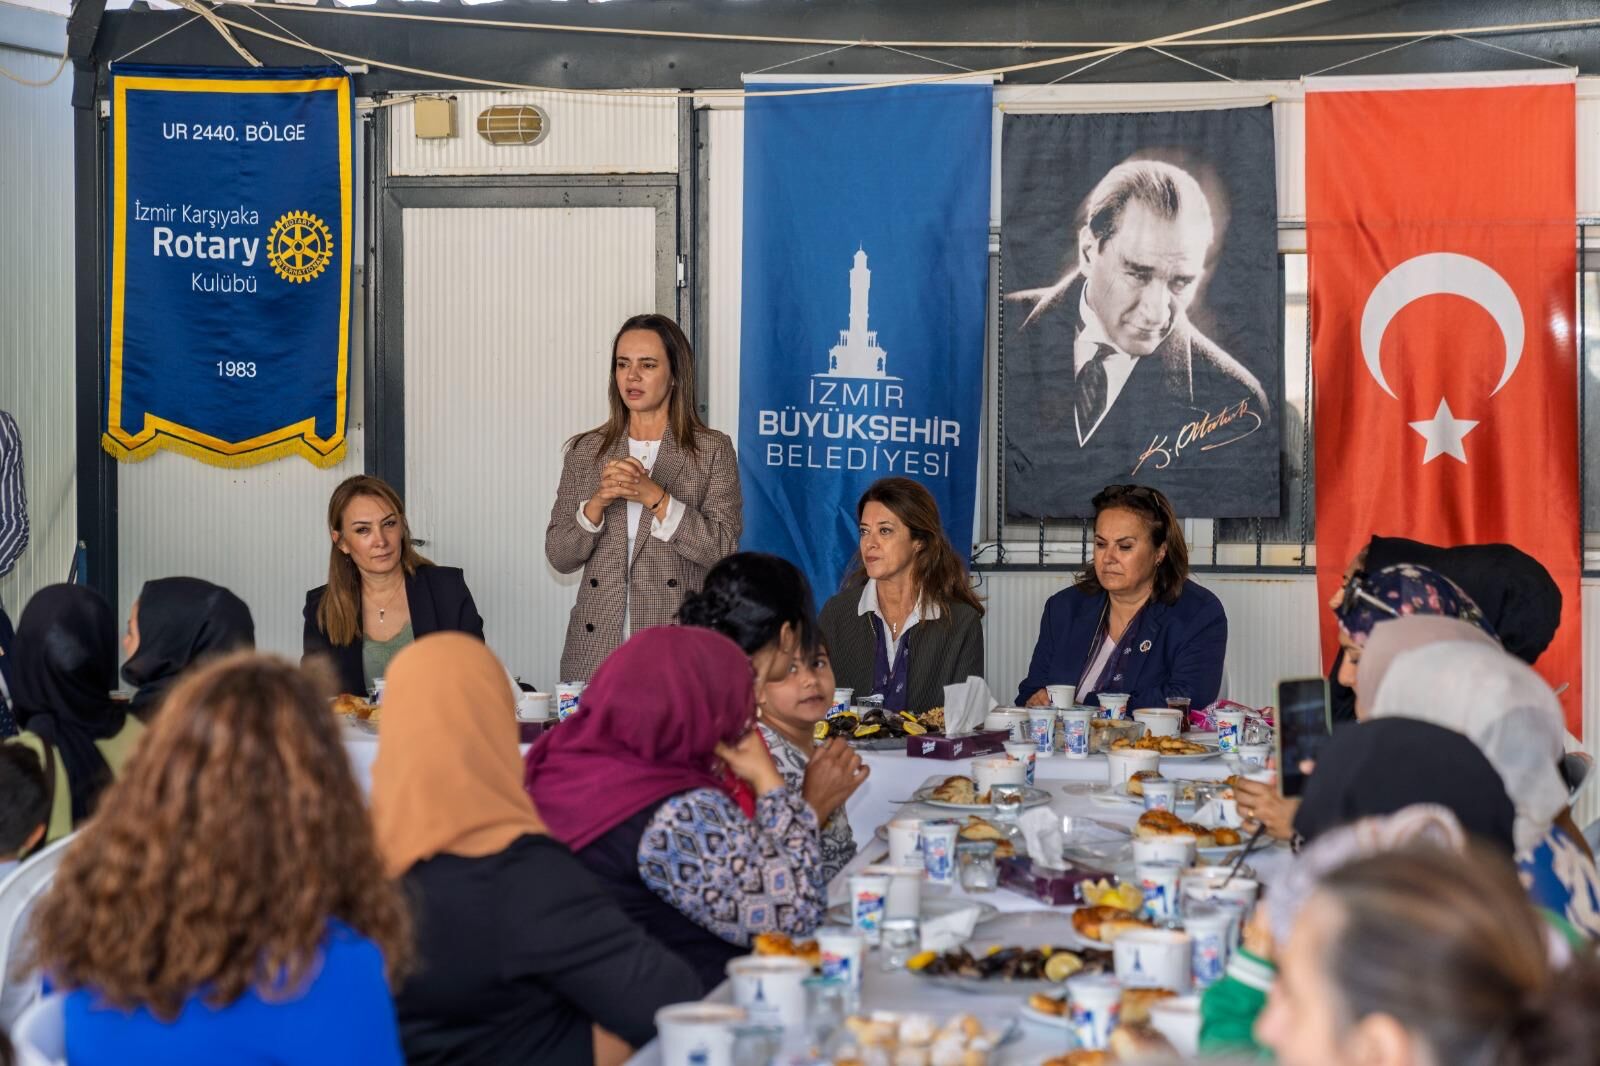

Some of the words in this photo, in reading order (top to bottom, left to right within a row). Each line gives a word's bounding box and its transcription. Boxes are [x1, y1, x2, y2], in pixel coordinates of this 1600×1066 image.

[163, 123, 188, 140] UR
[191, 124, 239, 142] 2440.
[245, 121, 305, 141] BÖLGE
[135, 199, 177, 221] İzmir
[181, 203, 259, 228] Karşıyaka
[285, 219, 312, 228] ROTARY
[152, 227, 259, 266] Rotary
[191, 273, 257, 293] Kulübü
[216, 361, 257, 378] 1983
[810, 379, 904, 408] İZMİR
[758, 406, 961, 447] BÜYÜKŞEHİR
[766, 442, 950, 478] BELEDİYESİ
